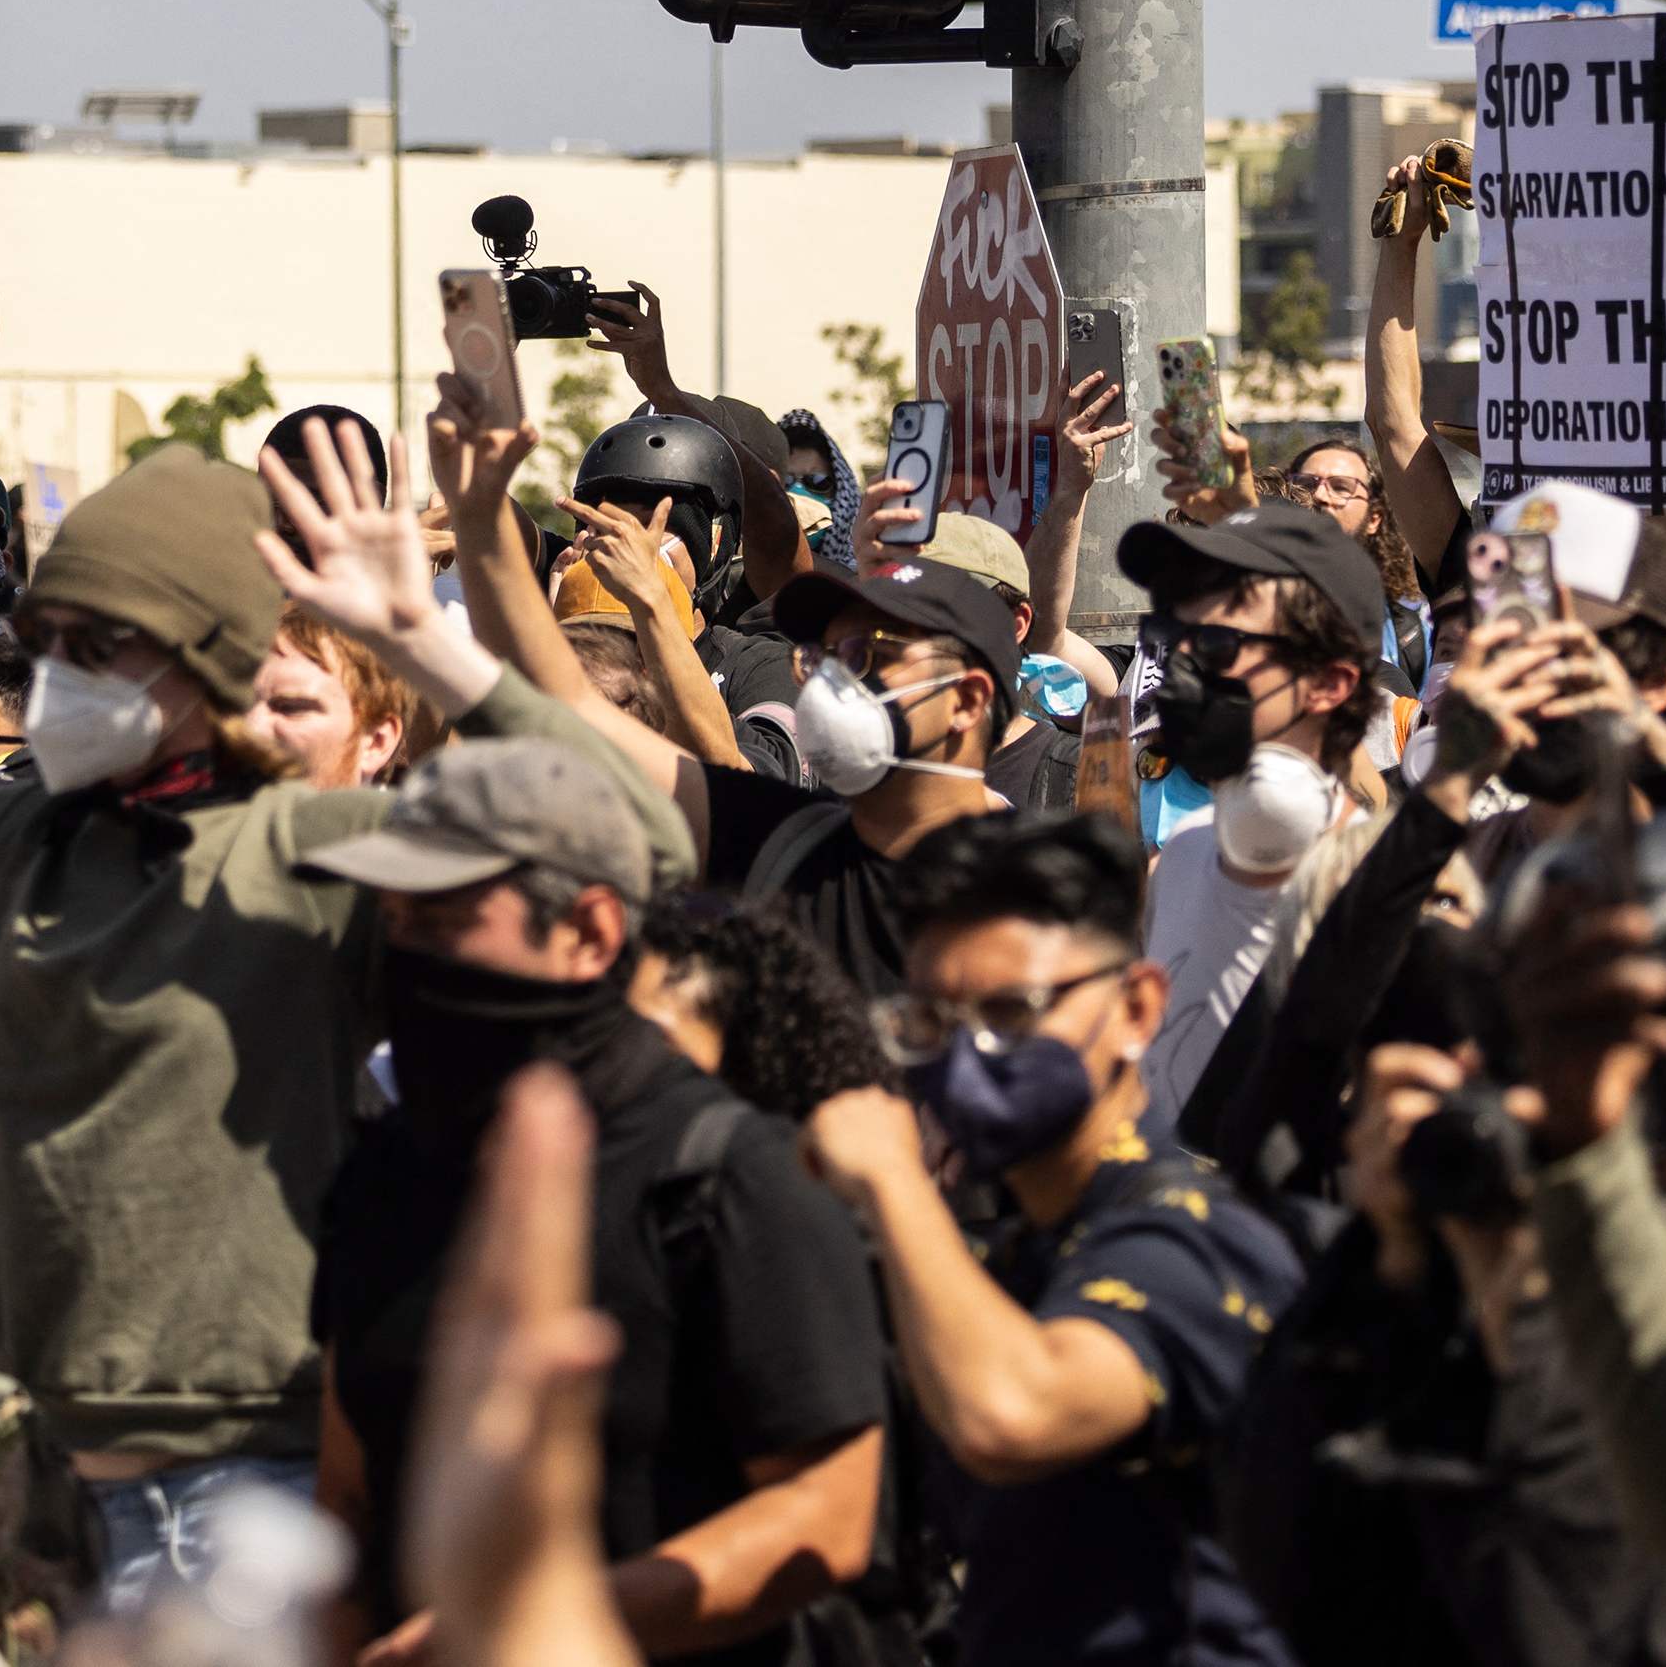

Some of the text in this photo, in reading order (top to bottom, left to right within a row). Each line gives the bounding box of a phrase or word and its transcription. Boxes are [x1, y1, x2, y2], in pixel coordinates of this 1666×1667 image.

[1483, 62, 1569, 129] STOP
[1485, 298, 1579, 365] STOP
[928, 316, 1050, 502] STOP
[1502, 474, 1533, 492] PATY
[1619, 475, 1631, 494] &
